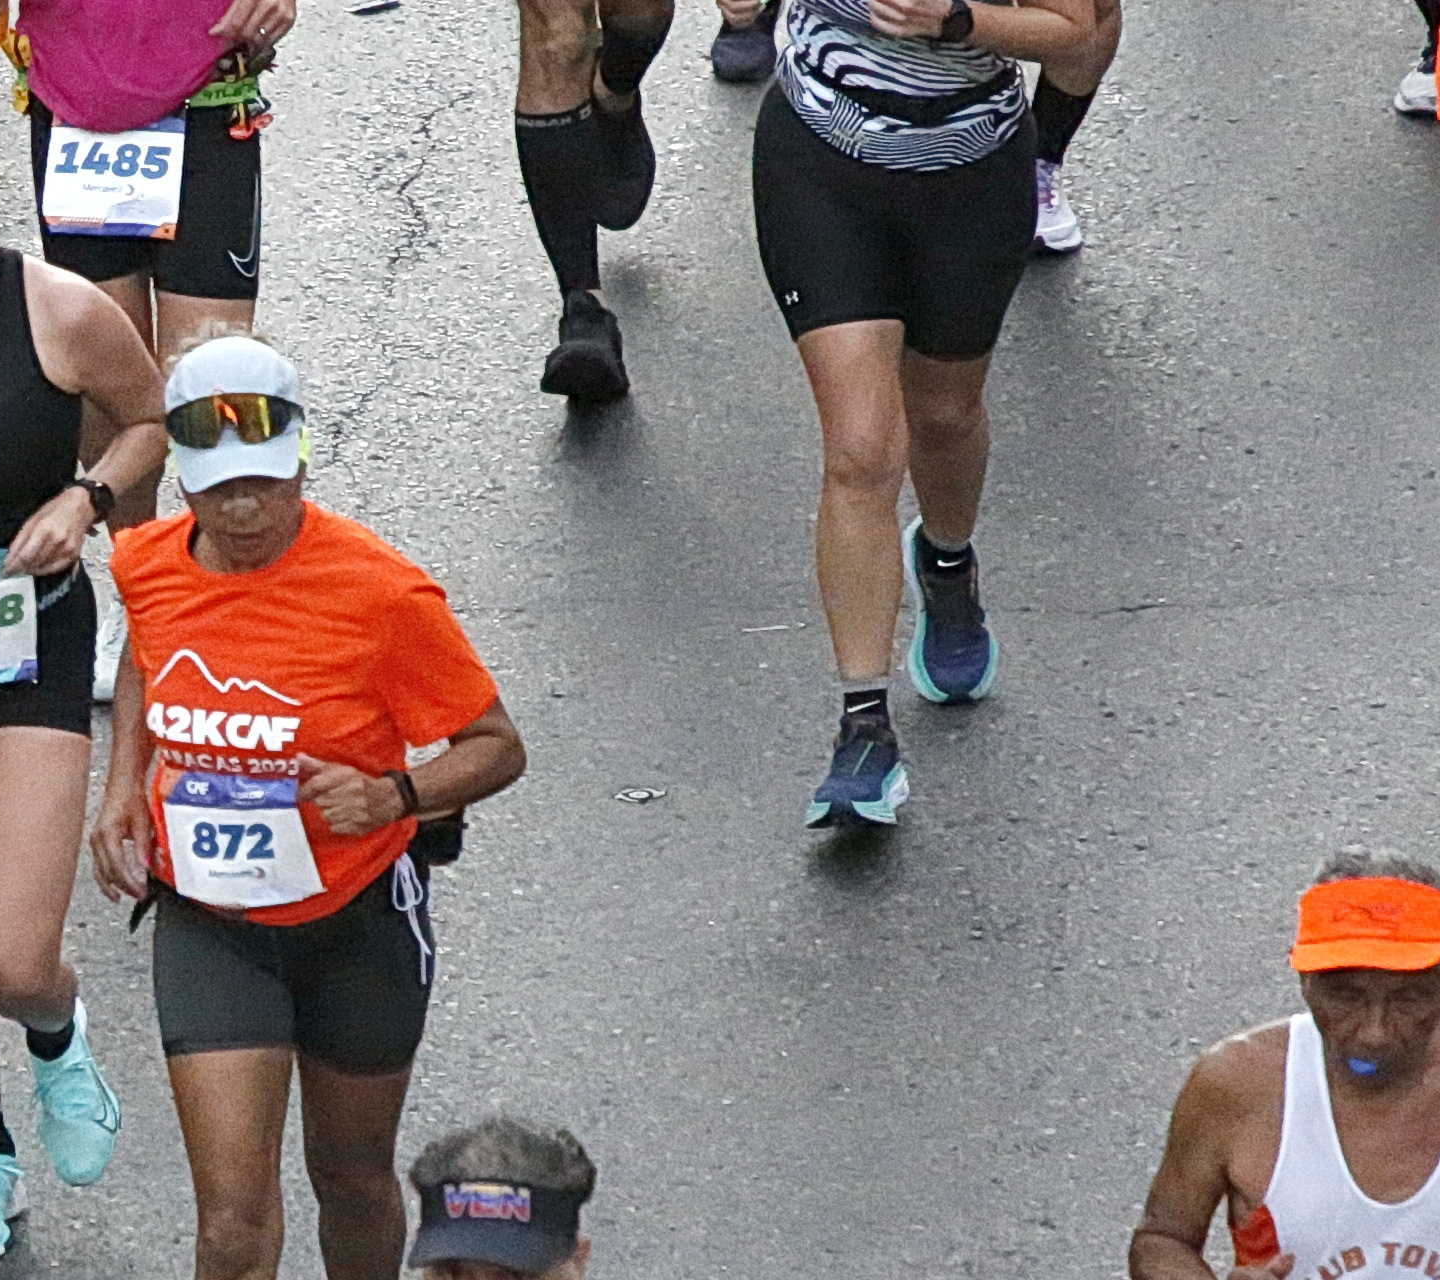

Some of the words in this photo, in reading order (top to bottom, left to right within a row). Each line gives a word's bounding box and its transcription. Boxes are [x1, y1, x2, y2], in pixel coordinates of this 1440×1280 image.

[54, 141, 173, 180] 1485
[191, 821, 275, 861] 872
[442, 1181, 532, 1223] VEN
